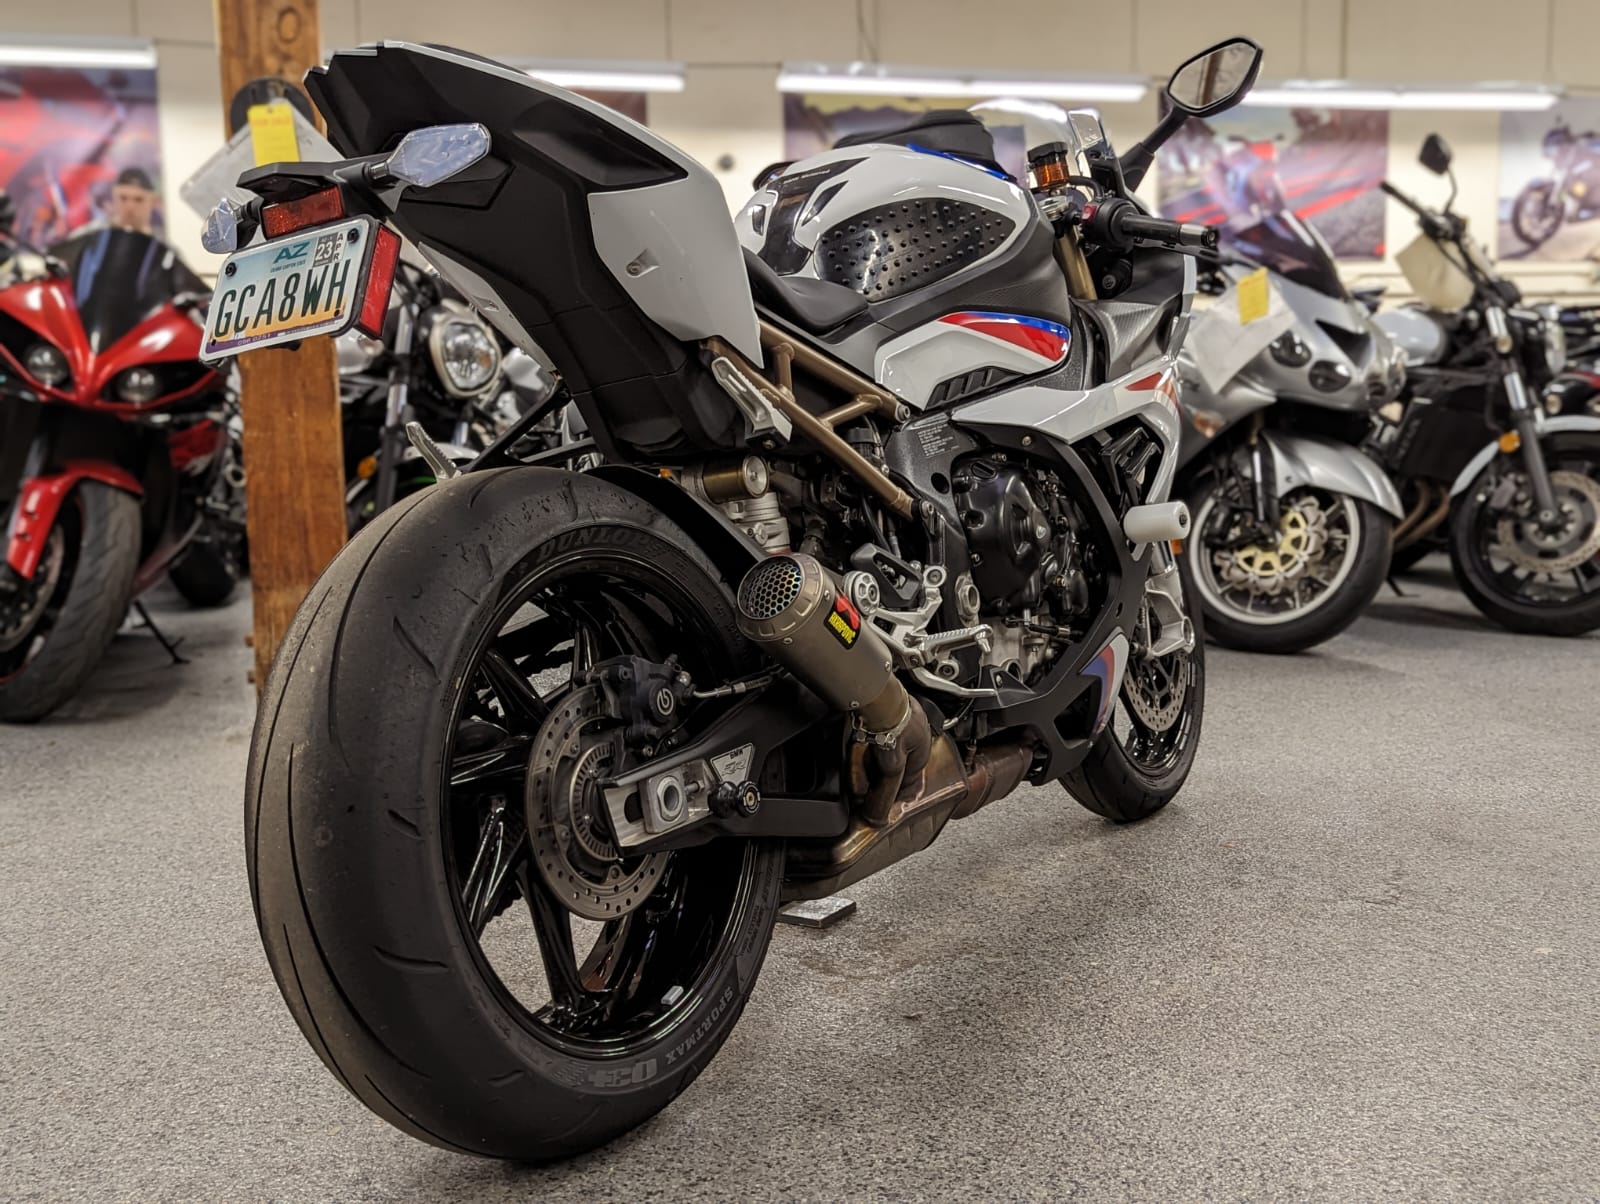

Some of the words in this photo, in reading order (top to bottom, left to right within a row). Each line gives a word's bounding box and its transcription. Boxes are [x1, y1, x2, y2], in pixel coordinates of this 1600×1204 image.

[273, 241, 310, 264] AZ
[315, 241, 334, 261] 23
[215, 259, 351, 337] GCA8WH
[538, 527, 648, 562] DUNLOP
[664, 986, 734, 1065] SPORTMAX
